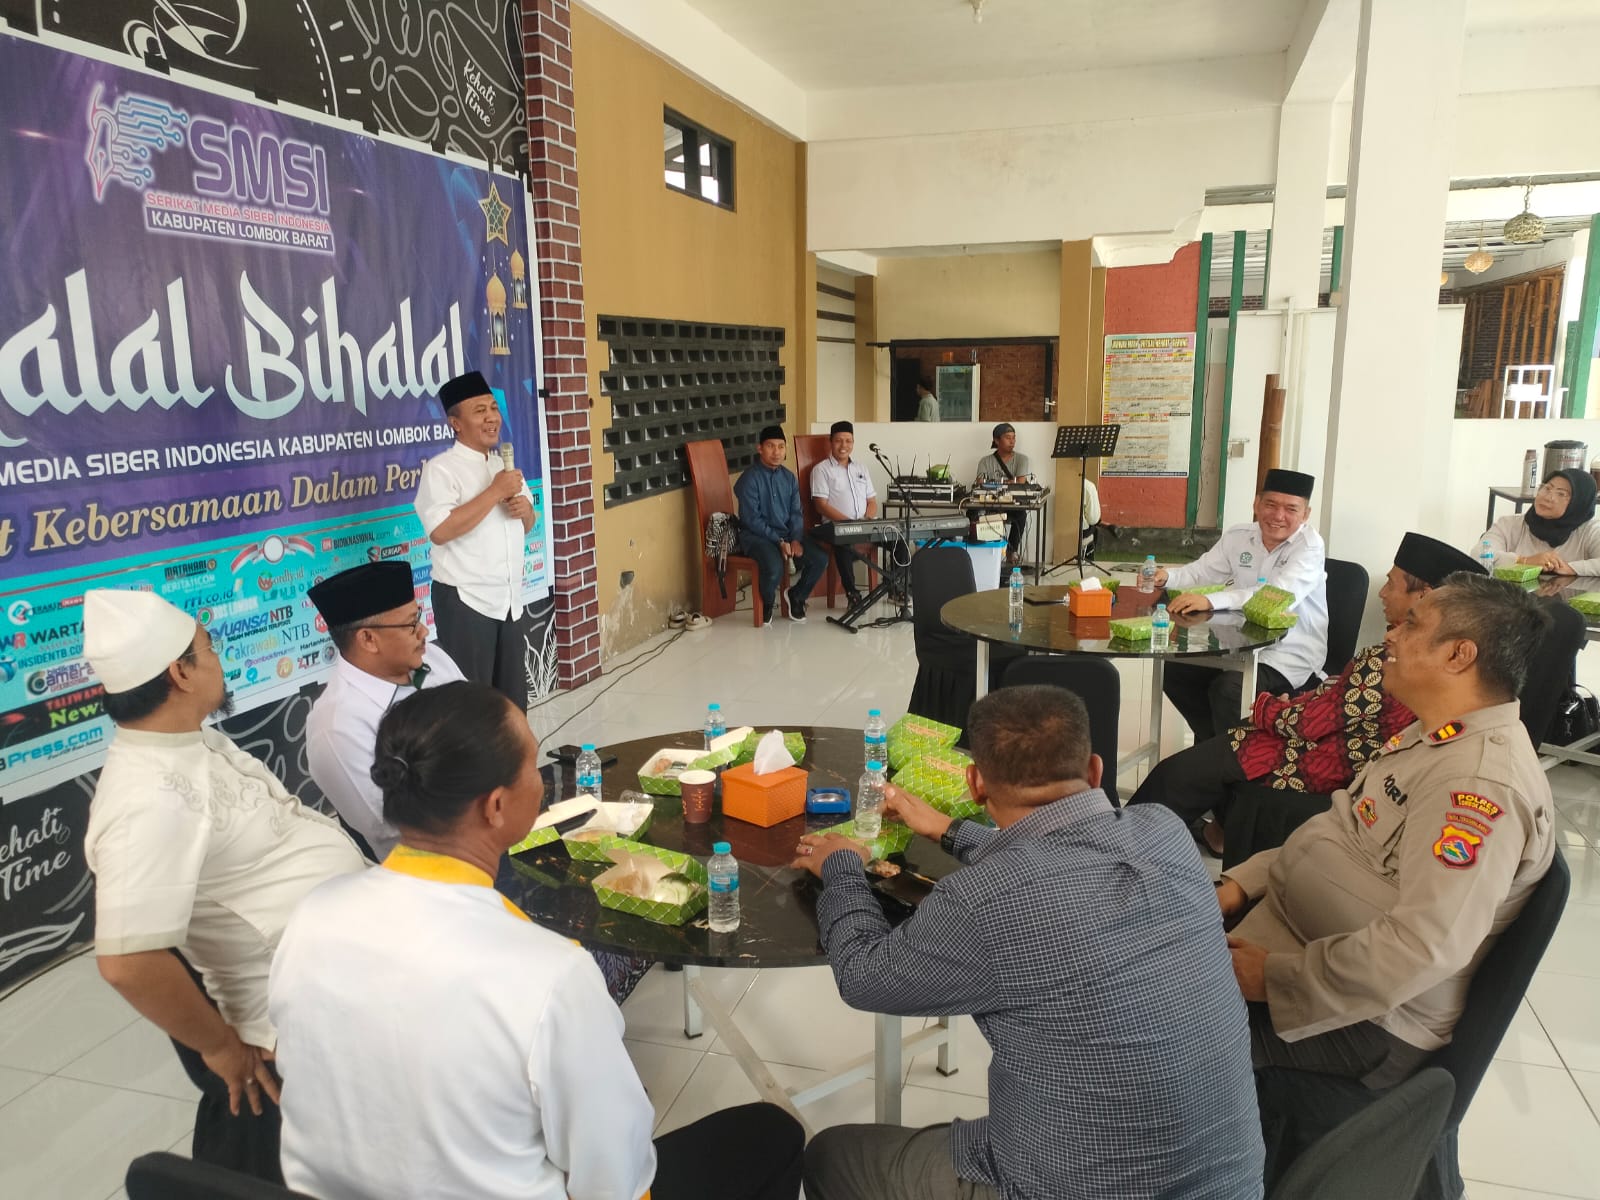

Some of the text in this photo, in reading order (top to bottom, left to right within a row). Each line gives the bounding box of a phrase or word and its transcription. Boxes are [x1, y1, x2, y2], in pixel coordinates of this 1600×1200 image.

[464, 59, 496, 107] Kehati
[466, 83, 492, 127] Time
[190, 119, 330, 214] SMSI
[146, 192, 330, 233] SERIKAT MEDIA SIBER INDONESIA
[151, 209, 329, 249] KABUPATEN LOMBOK BARAT
[0, 267, 465, 447] alal Bihalal
[86, 449, 161, 477] SIBER
[165, 438, 275, 469] INDONESIA
[278, 430, 378, 457] KABUPATEN
[376, 424, 431, 447] LOMBOK
[30, 487, 283, 552] Kebersamaan
[291, 471, 378, 508] Dalam
[269, 605, 293, 624] NTB
[282, 622, 311, 645] NTB
[1457, 794, 1499, 815] POLRES
[0, 808, 62, 864] ehati
[0, 850, 71, 901] Time
